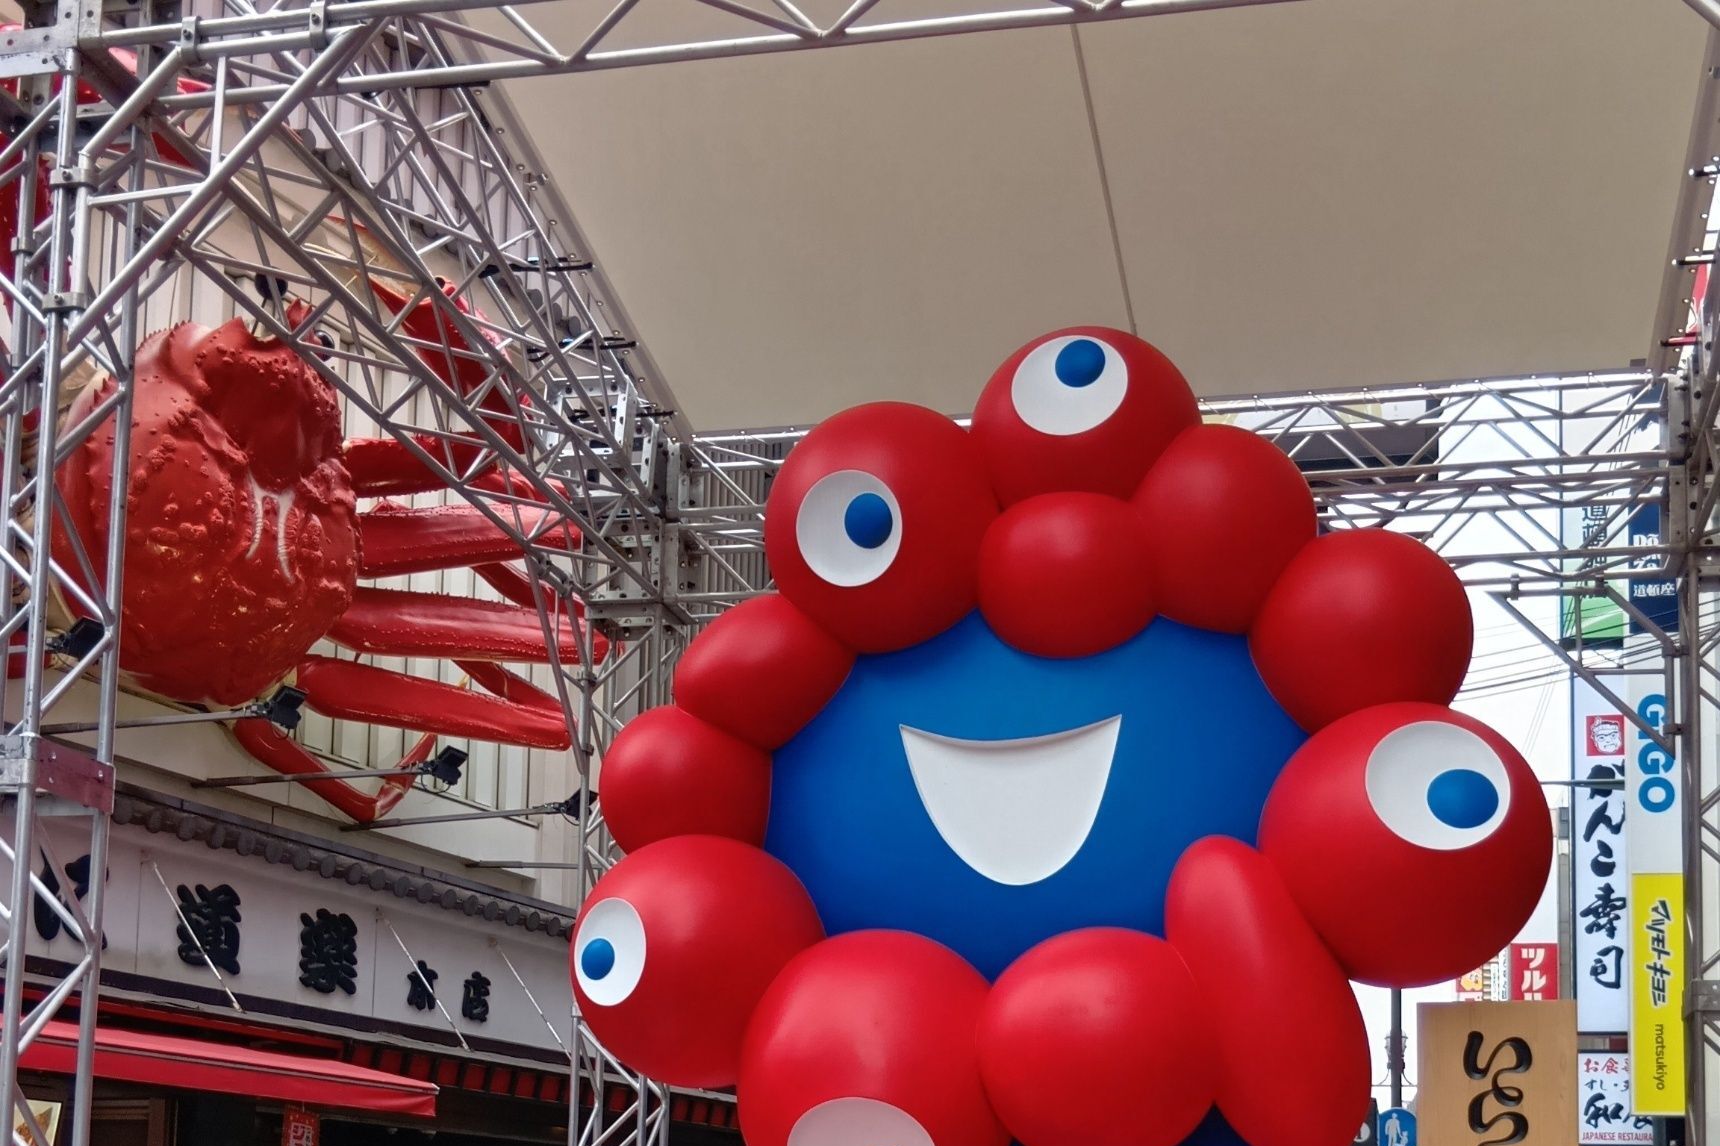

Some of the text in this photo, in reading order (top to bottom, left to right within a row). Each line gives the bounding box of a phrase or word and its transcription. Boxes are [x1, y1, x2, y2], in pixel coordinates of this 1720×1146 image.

[1646, 899, 1671, 1007] マツモトキヨシ
[1653, 1024, 1668, 1091] matsukiyo
[1583, 1132, 1653, 1141] JAPANESE RESTAURA
